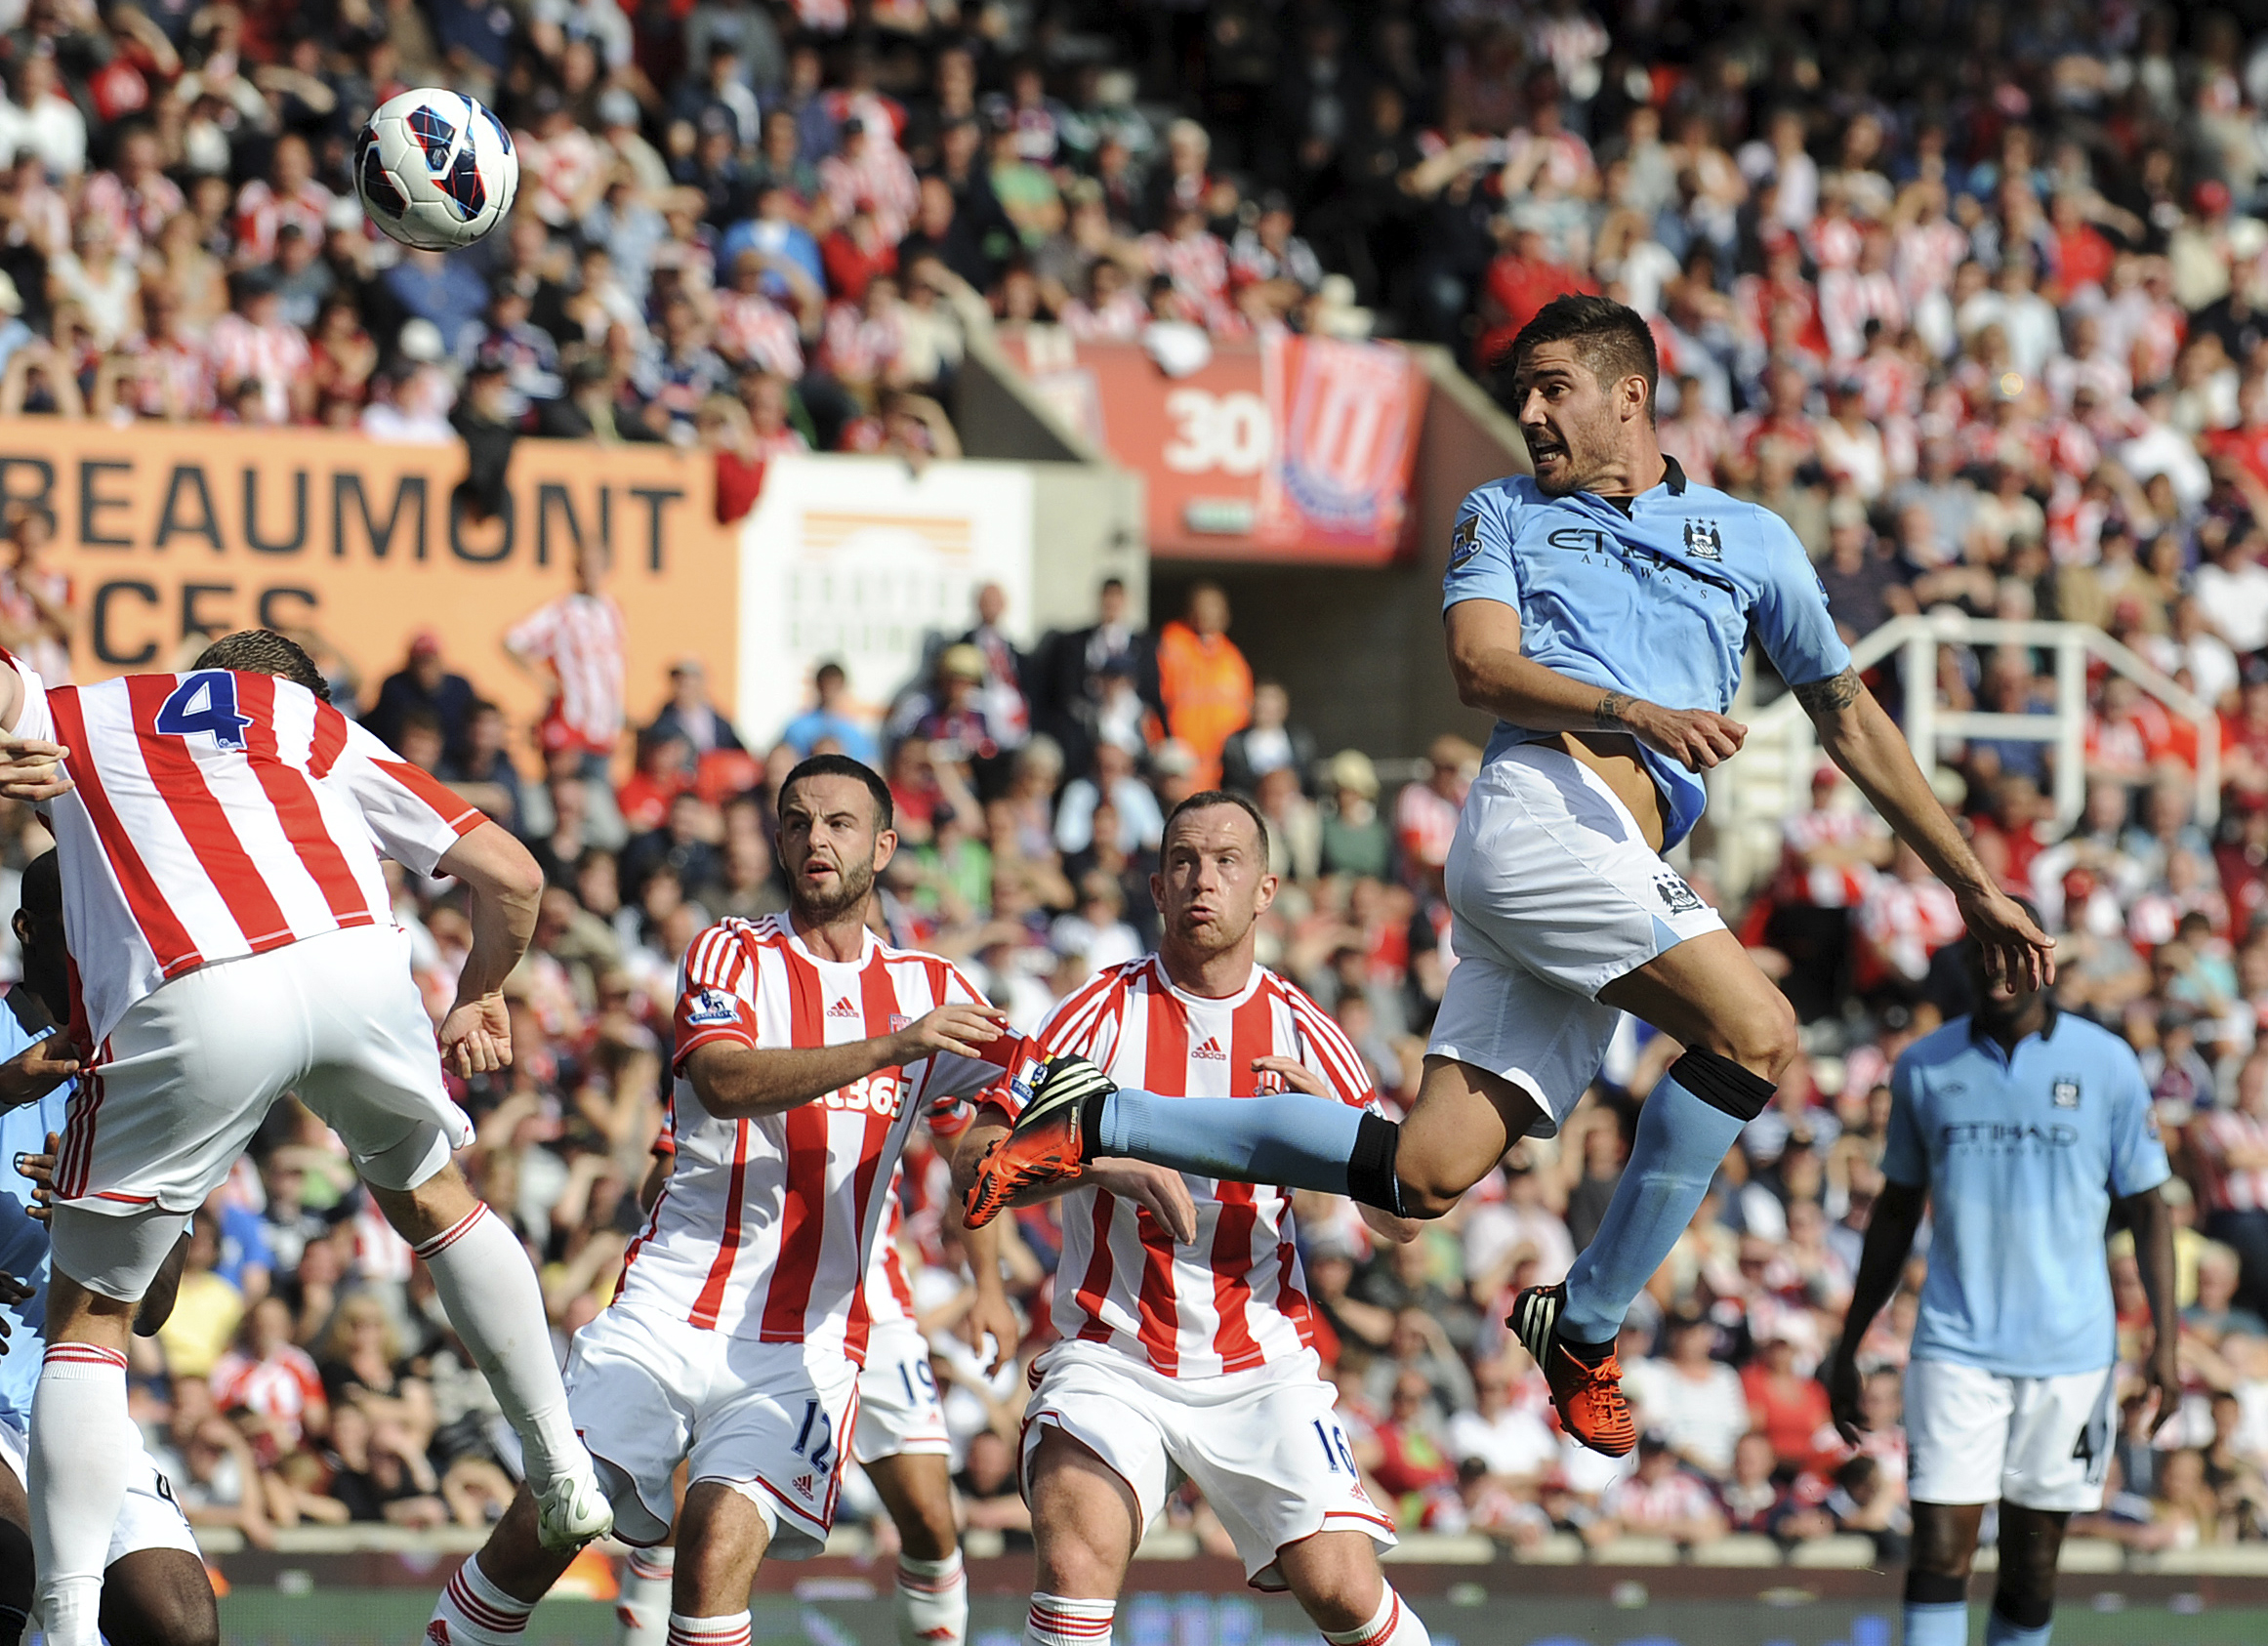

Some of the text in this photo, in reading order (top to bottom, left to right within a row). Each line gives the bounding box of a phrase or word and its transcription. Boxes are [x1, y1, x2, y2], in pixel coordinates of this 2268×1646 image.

[1163, 388, 1272, 474] 30
[0, 456, 685, 572] BEAUMONT
[153, 668, 255, 751] 4
[1191, 1049, 1226, 1061] adidas
[812, 1076, 911, 1119] t365
[897, 1358, 939, 1407] 19
[791, 1399, 831, 1477] 12
[1309, 1417, 1358, 1479] 16
